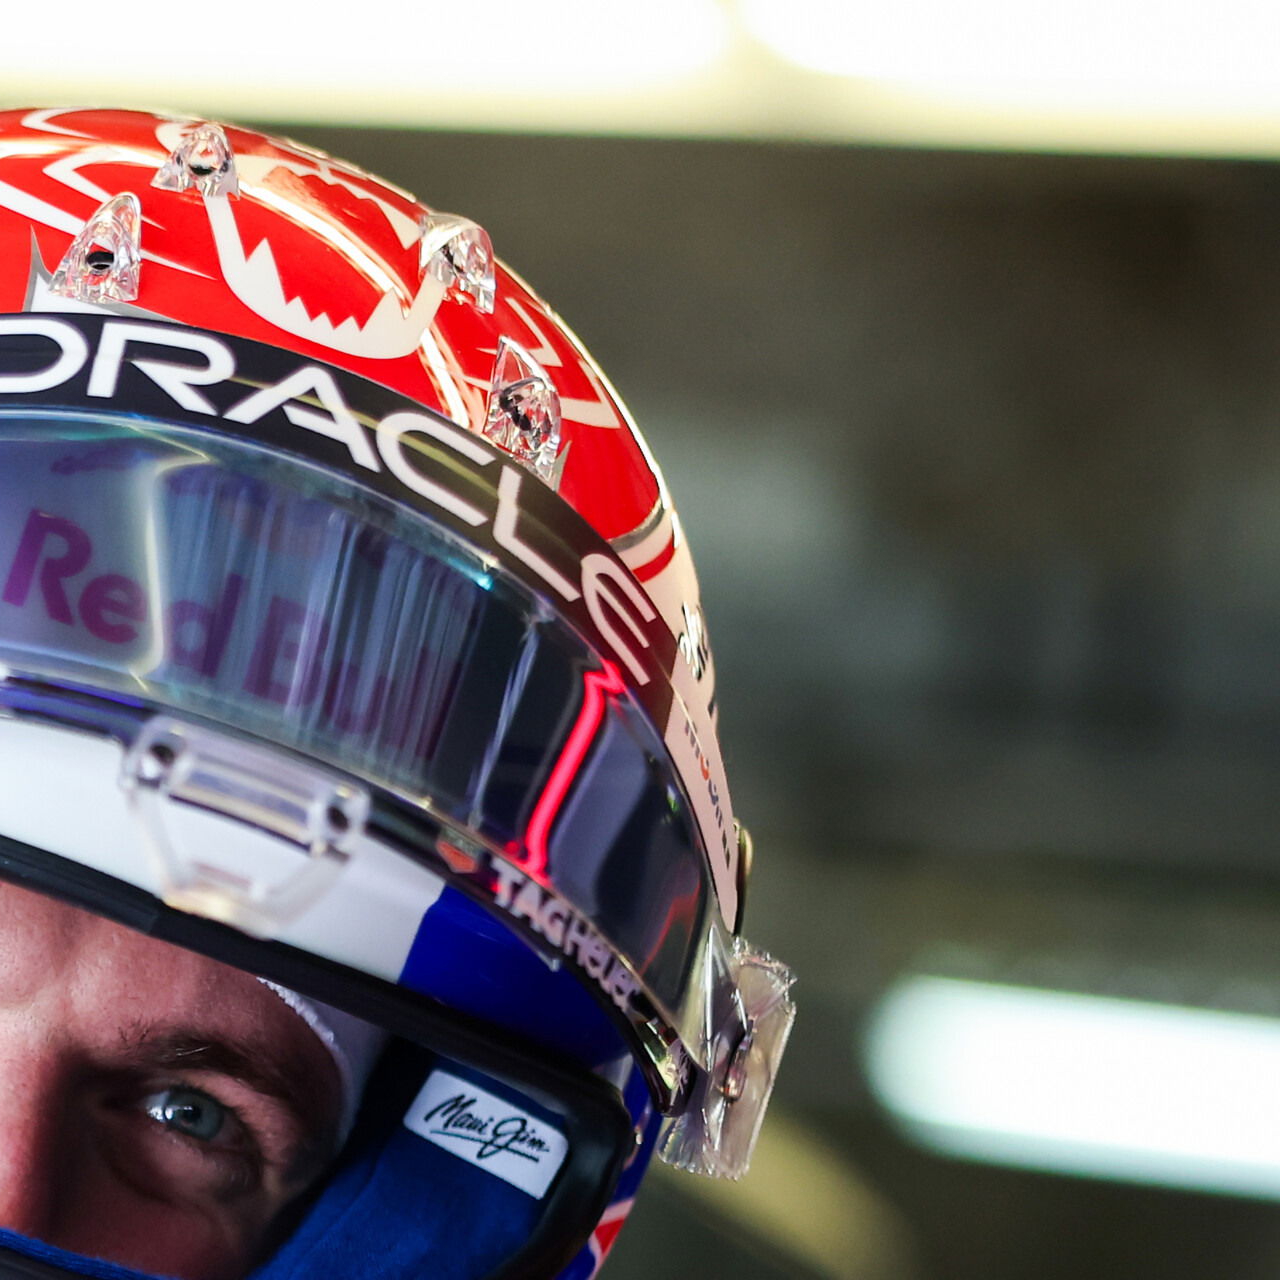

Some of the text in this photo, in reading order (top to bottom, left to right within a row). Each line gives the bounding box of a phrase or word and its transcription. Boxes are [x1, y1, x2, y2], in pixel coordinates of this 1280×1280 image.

[1, 508, 245, 679] Red
[423, 1093, 551, 1160] Maui Jim
